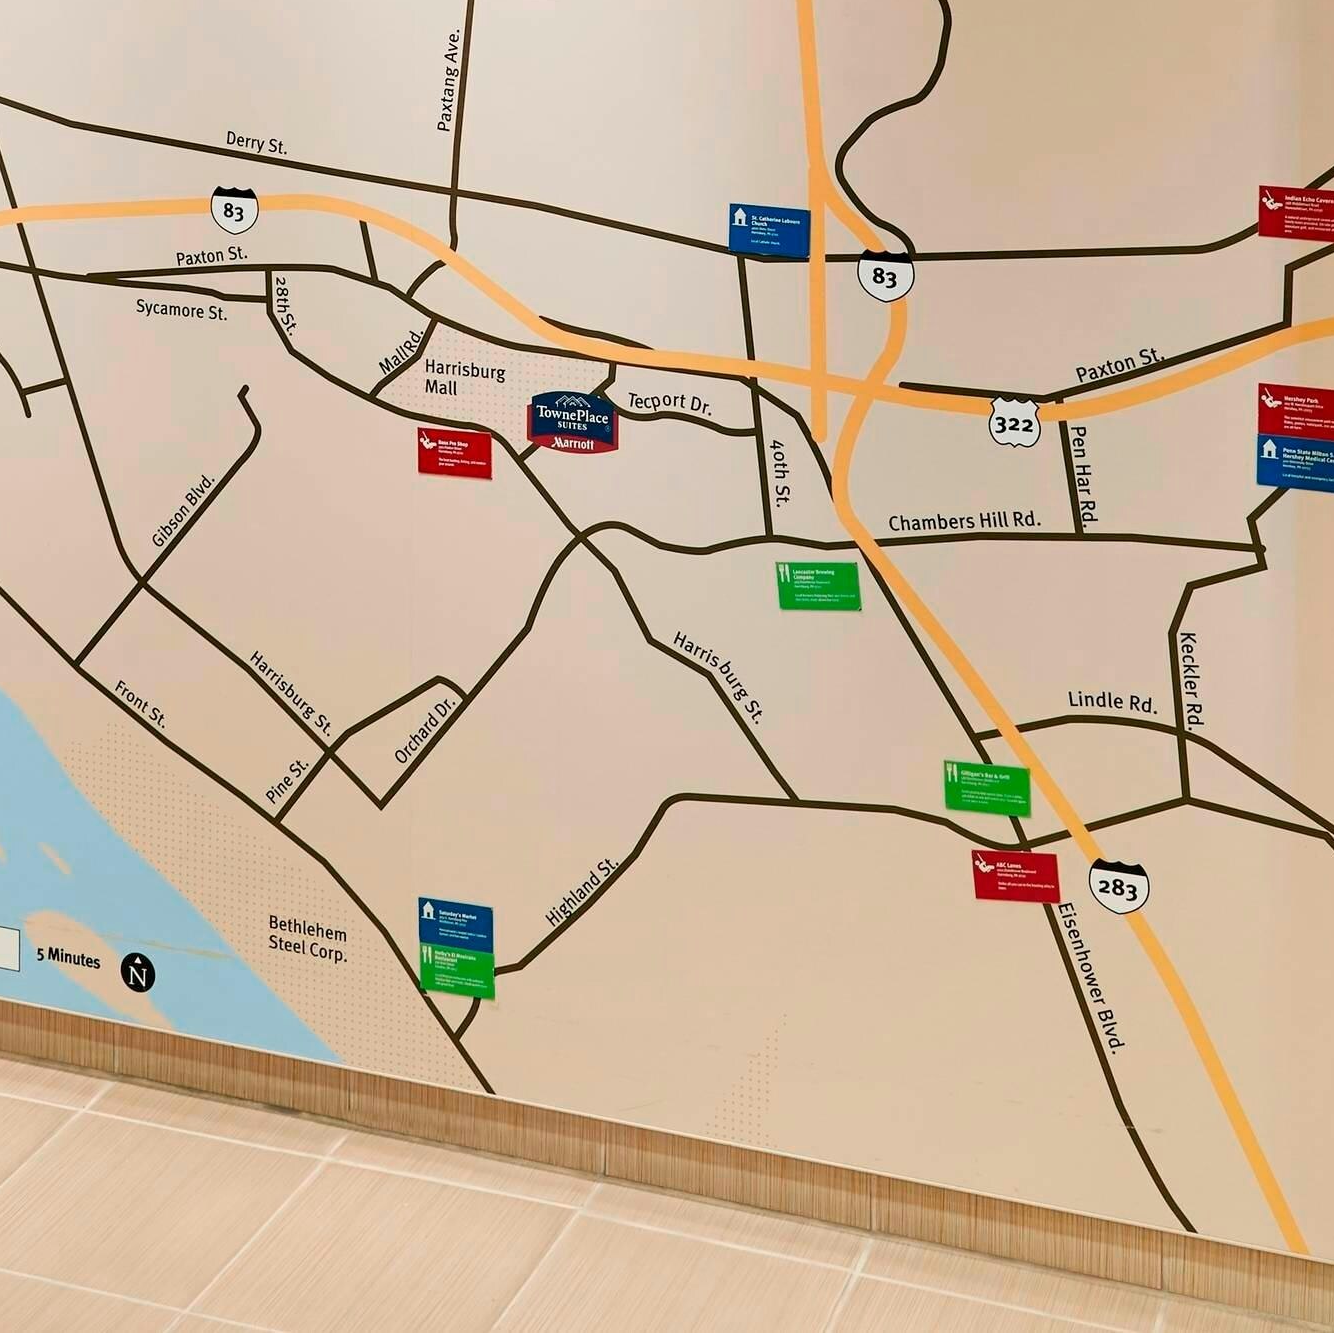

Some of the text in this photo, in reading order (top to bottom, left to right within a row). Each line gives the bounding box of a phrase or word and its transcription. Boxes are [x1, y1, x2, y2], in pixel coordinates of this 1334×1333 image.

[437, 28, 461, 132] Paxtang Ave.
[226, 131, 288, 155] Derry St.
[223, 204, 244, 222] 83
[176, 246, 248, 266] Paxton St.
[871, 267, 897, 290] 83
[136, 299, 228, 321] Sycamore St.
[275, 277, 298, 336] 28th St.
[378, 328, 425, 375] Mall Rd.
[425, 359, 505, 383] Harrisburg
[1076, 347, 1166, 384] Paxton St.
[425, 380, 457, 396] Mall
[536, 405, 608, 424] TownePlace
[628, 392, 713, 416] Tecport Dr.
[558, 421, 587, 430] SUITES
[995, 416, 1034, 434] 322
[551, 437, 594, 450] Marriott
[769, 439, 790, 508] 40th St.
[1071, 426, 1098, 528] Pen Har Rd.
[151, 474, 215, 549] Gibson Blvd.
[889, 509, 1041, 531] Chambers Hill Rd.
[673, 631, 763, 725] Harrisburg St.
[1180, 632, 1204, 730] Keckler Rd.
[114, 680, 168, 729] Front St.
[249, 650, 333, 738] Harrisburg St.
[1068, 690, 1158, 715] Lindle Rd.
[394, 696, 456, 766] Orchard Dr.
[265, 758, 309, 805] Pine St.
[546, 856, 620, 928] Highland St.
[1098, 878, 1138, 903] 283
[439, 910, 461, 918] Saturday's
[269, 914, 348, 943] Bethlehem
[37, 947, 100, 970] 5 Minutes
[269, 933, 348, 965] Steel Corp.
[128, 966, 148, 987] N
[1058, 902, 1126, 1055] Eisenhower Blvd.
